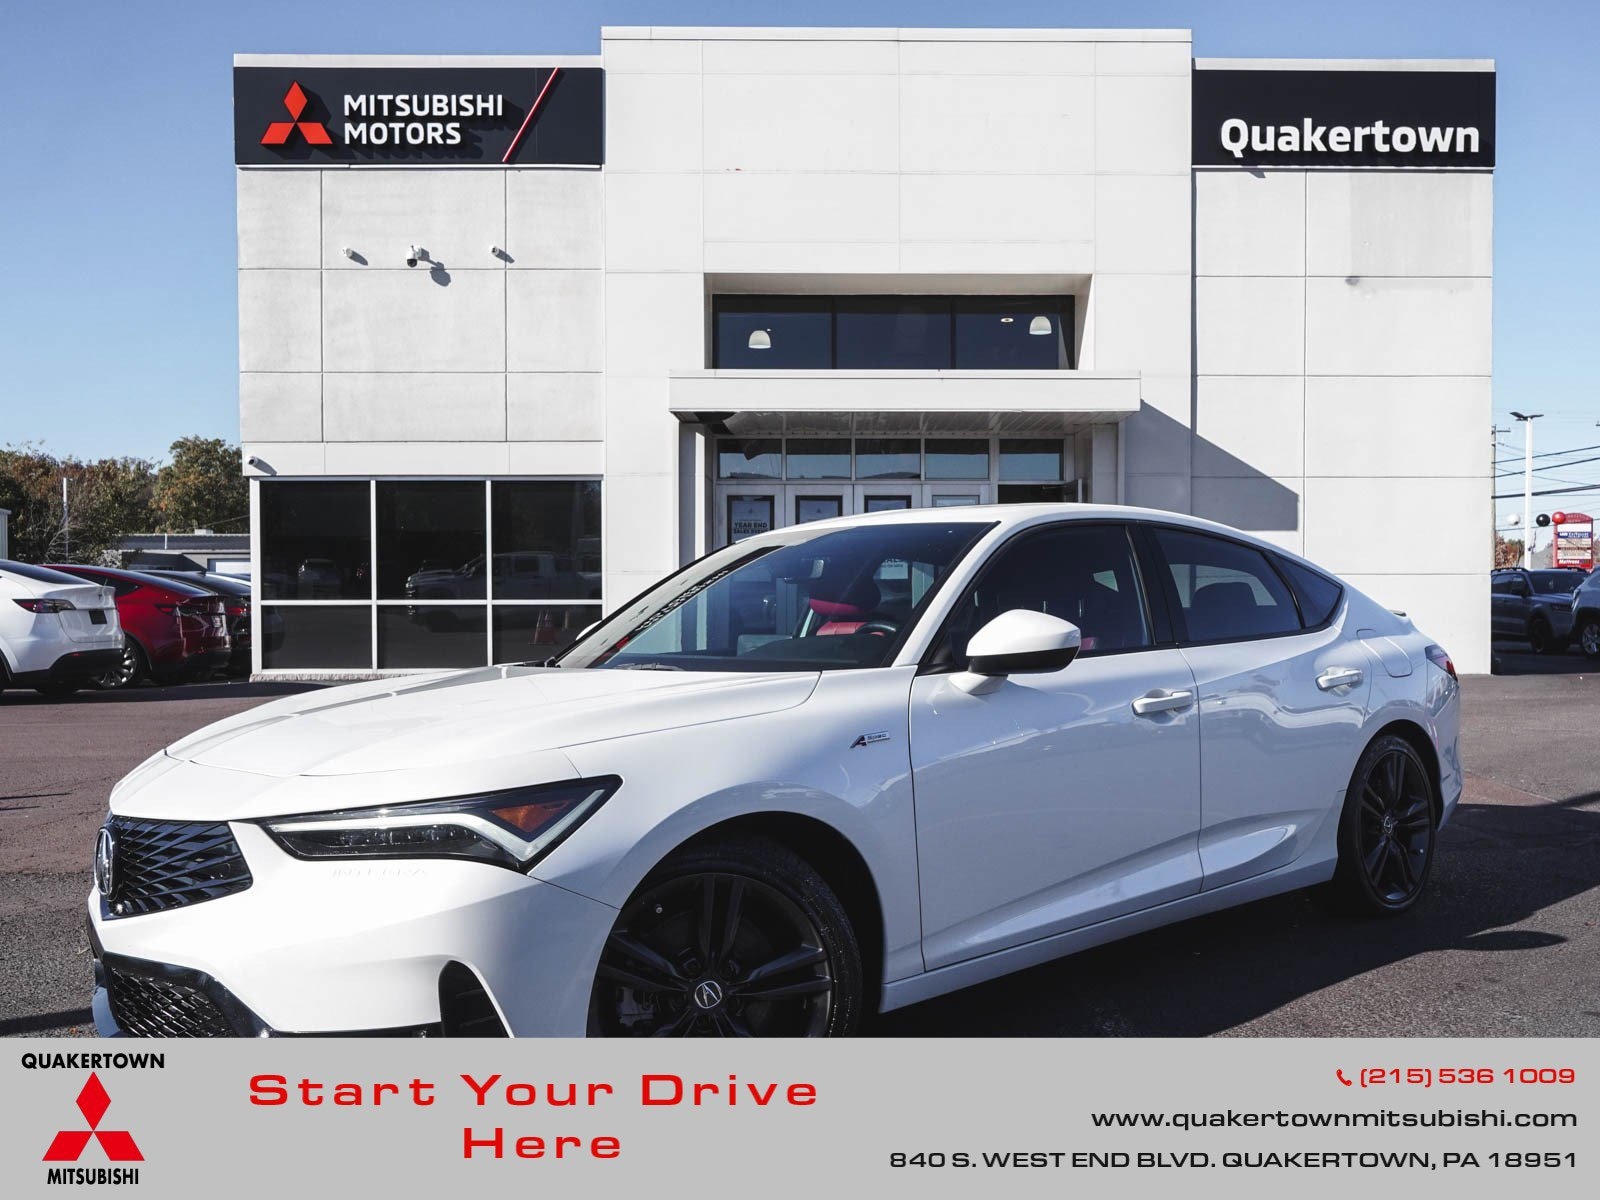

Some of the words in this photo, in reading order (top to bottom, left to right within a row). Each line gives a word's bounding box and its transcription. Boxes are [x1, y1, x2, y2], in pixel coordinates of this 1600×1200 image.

[343, 94, 503, 117] MITSUBISHI
[344, 122, 461, 145] MOTORS
[1220, 117, 1480, 158] Quakertown
